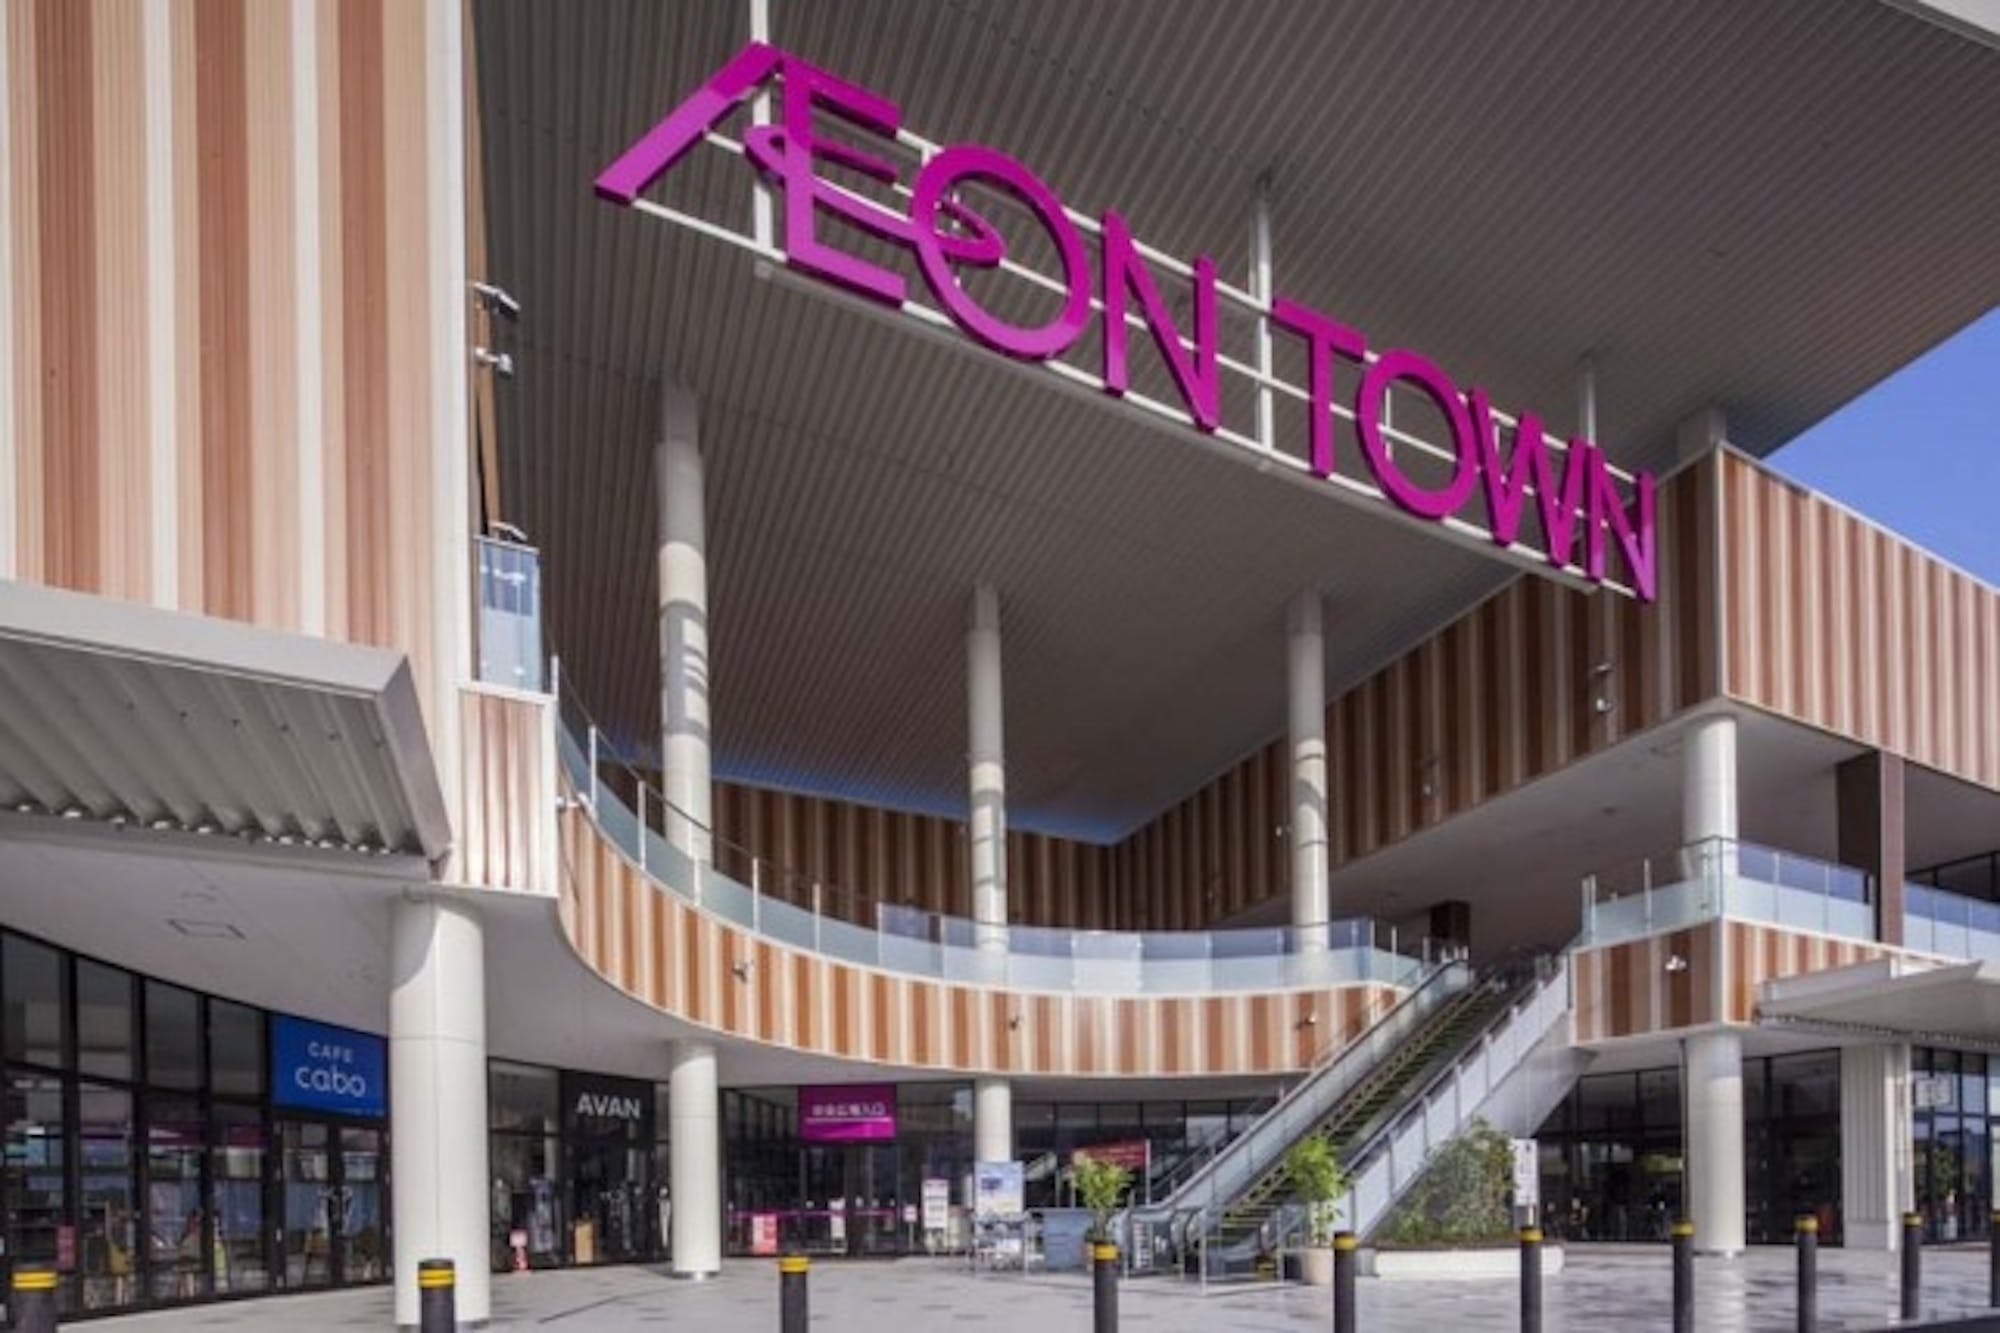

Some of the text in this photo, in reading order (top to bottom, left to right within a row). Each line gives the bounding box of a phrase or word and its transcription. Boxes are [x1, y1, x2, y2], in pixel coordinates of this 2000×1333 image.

[1271, 297, 1656, 603] TOWN
[307, 1041, 354, 1062] CAFE
[295, 1064, 366, 1098] cabo
[576, 1092, 641, 1119] AVAN
